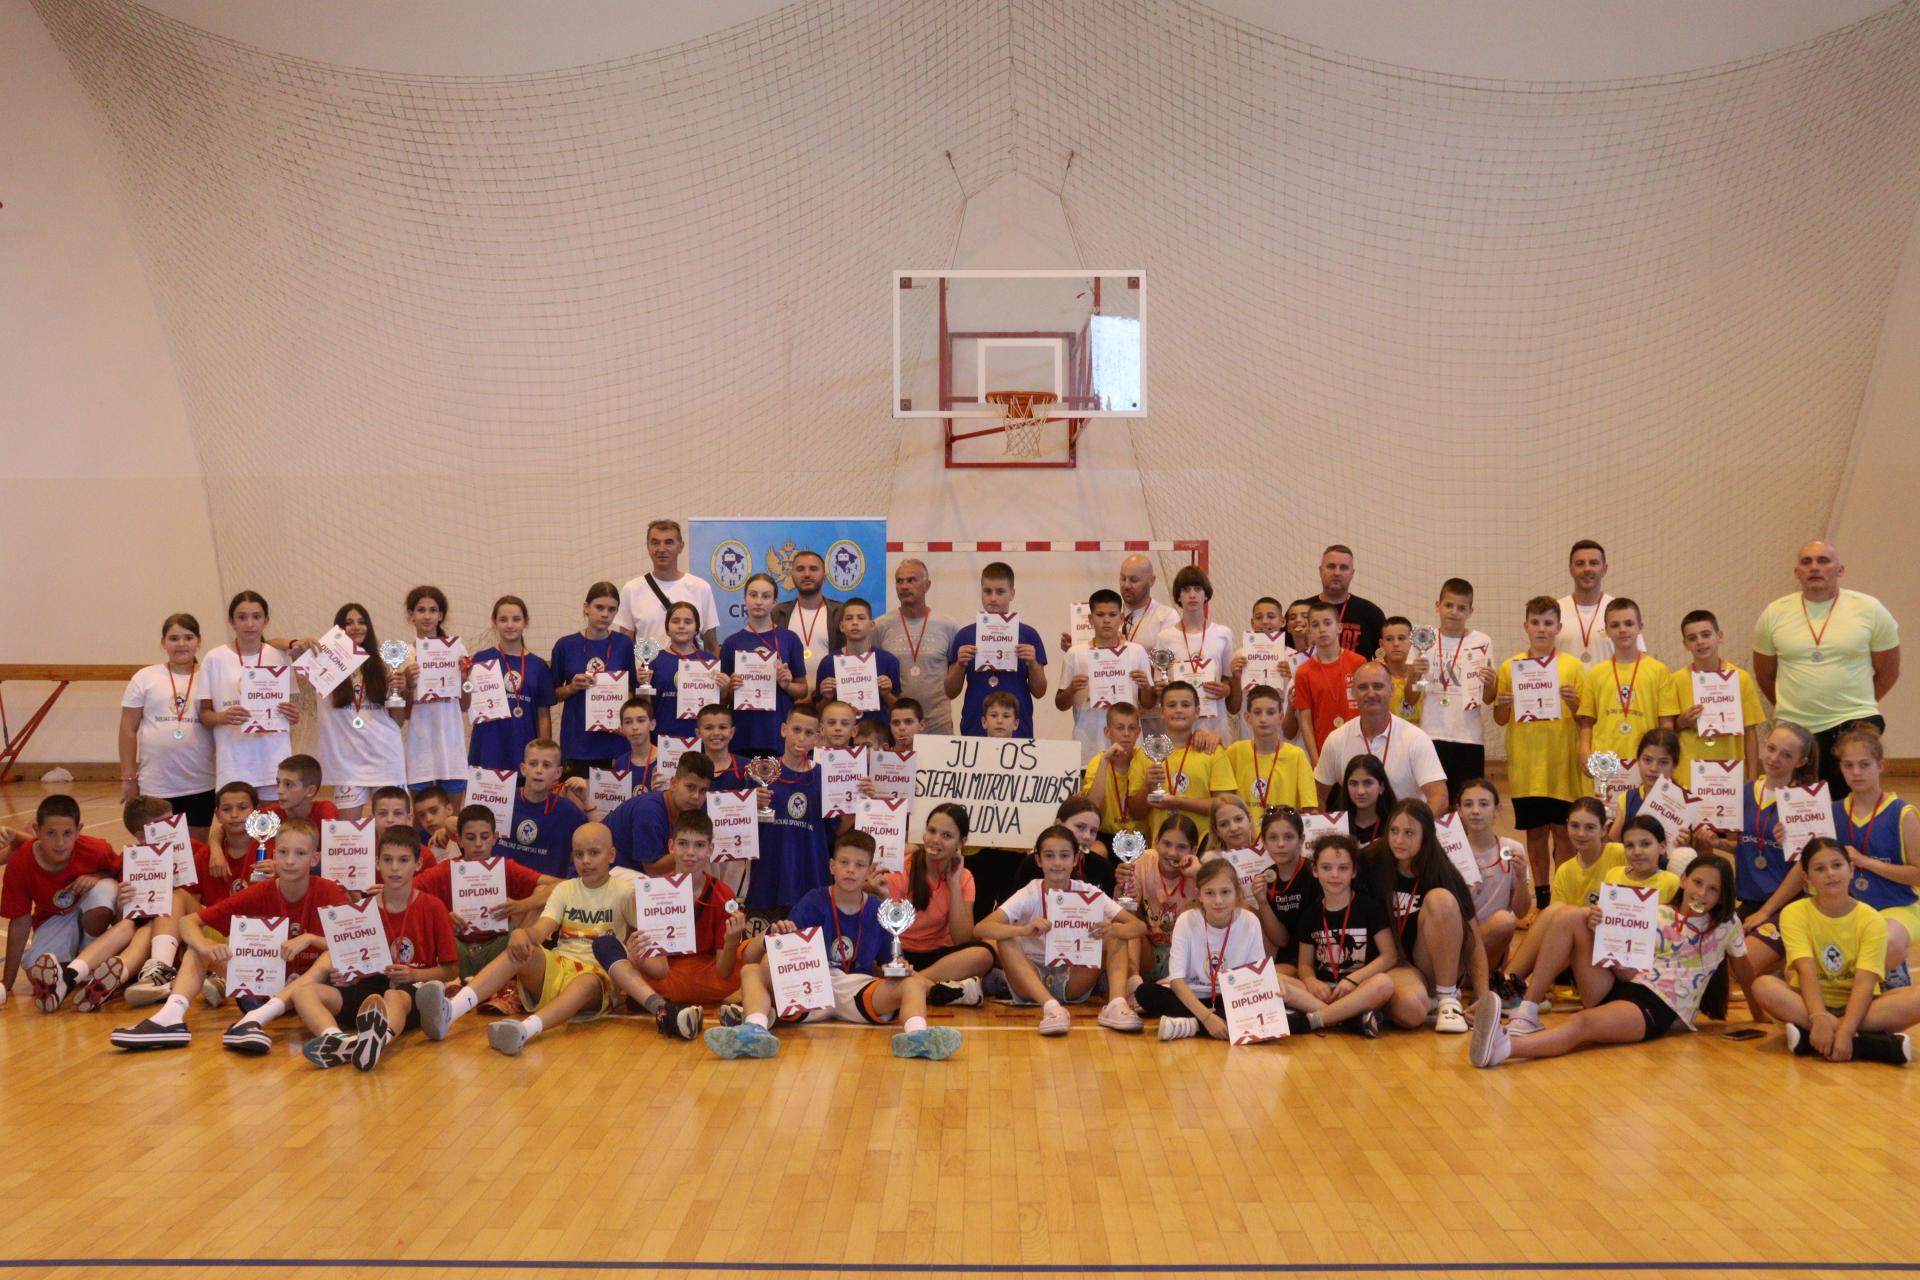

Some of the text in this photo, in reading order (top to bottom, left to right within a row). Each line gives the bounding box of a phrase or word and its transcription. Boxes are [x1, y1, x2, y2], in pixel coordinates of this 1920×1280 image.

[981, 634, 1012, 643] DIPLOMU
[320, 644, 347, 672] DIPLOMU
[996, 650, 1002, 659] 3
[1248, 654, 1278, 662] DIPLOMU
[422, 661, 456, 669] DIPLOMU
[1094, 669, 1126, 678] DIPLOMU
[1263, 669, 1268, 678] 1
[440, 677, 444, 686] 1
[841, 676, 872, 684] DIPLOMU
[683, 682, 715, 690] DIPLOMU
[1110, 685, 1116, 694] 1
[1518, 682, 1553, 690] DIPLOMU
[248, 692, 283, 700] DIPLOMU
[591, 694, 622, 702] DIPLOMU
[755, 688, 761, 698] 3
[858, 690, 864, 700] 3
[488, 699, 494, 709] 3
[698, 698, 704, 706] 3
[1537, 698, 1543, 708] 1
[1700, 696, 1735, 704] DIPLOMU
[266, 708, 272, 719] 1
[607, 709, 614, 718] 3
[1719, 712, 1725, 722] 1
[946, 739, 1037, 770] JU OŠ
[828, 773, 862, 783] DIPLOMU
[874, 774, 910, 782] DIPLOMU
[914, 769, 967, 799] STEFAN
[967, 773, 1020, 803] MITROV
[846, 791, 852, 801] 3
[1697, 787, 1736, 796] DIPLOMU
[472, 793, 508, 804] DIPLOMU
[594, 792, 626, 802] DIPLOMU
[1649, 802, 1684, 827] DIPLOMU
[1716, 805, 1724, 816] 2
[715, 817, 751, 826] DIPLOMU
[962, 805, 1021, 834] UDVA
[1786, 813, 1824, 824] DIPLOMU
[734, 835, 741, 846] 3
[328, 848, 368, 857] DIPLOMU
[878, 845, 884, 858] 1
[172, 863, 178, 874] 2
[348, 866, 356, 877] 2
[129, 871, 166, 882] DIPLOMU
[148, 890, 156, 902] 2
[458, 886, 498, 897] DIPLOMU
[480, 906, 488, 918] 2
[564, 905, 612, 924] HAWAII
[644, 906, 686, 916] DIPLOMU
[1054, 920, 1096, 929] DIPLOMU
[1605, 916, 1649, 929] DIPLOMU
[334, 927, 376, 943] DIPLOMU
[666, 926, 676, 938] 2
[1074, 938, 1080, 951] 1
[1626, 938, 1632, 952] 1
[236, 948, 278, 958] DIPLOMU
[360, 948, 370, 961] 2
[778, 960, 820, 974] DIPLOMU
[255, 968, 264, 982] 2
[802, 981, 812, 994] 3
[1232, 991, 1273, 1008] DIPLOMU
[1257, 1013, 1264, 1025] 1
